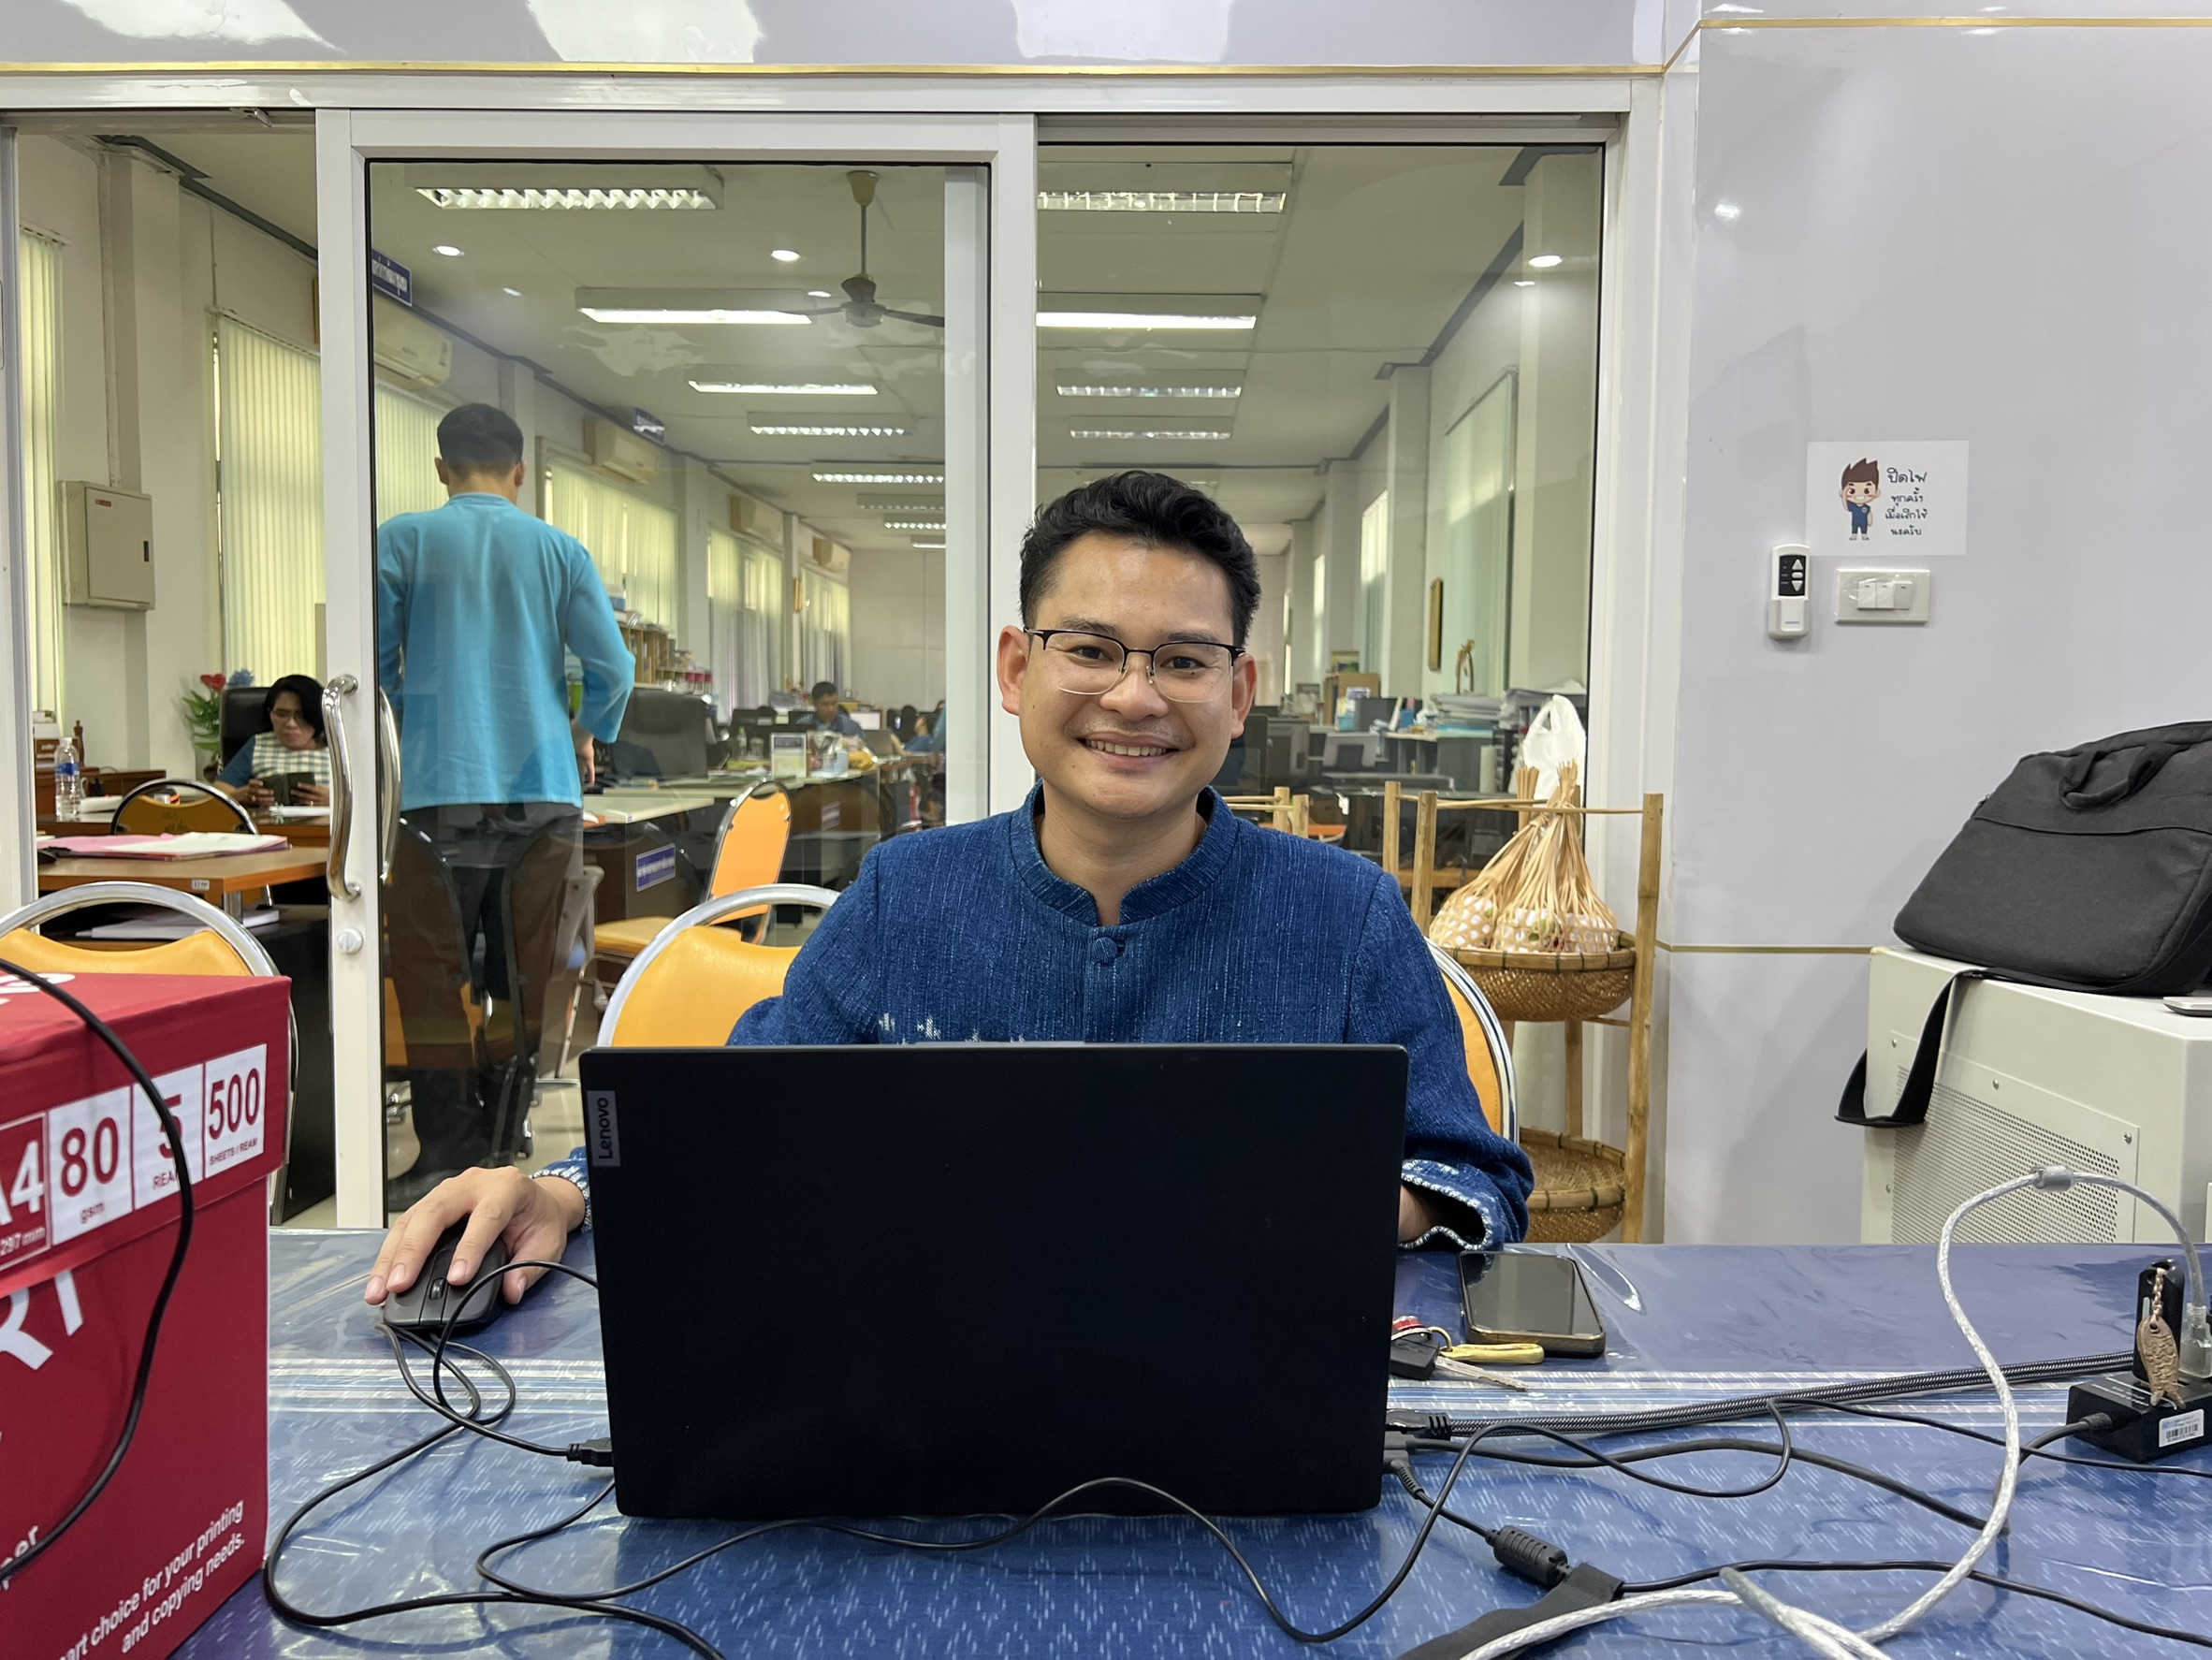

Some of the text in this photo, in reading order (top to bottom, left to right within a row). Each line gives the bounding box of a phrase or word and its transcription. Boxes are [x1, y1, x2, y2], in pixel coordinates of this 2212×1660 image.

[1886, 467, 1928, 483] ปิดไฟ
[1890, 487, 1924, 506] ทุกครั้ง
[1890, 524, 1922, 535] นะครับ
[209, 1068, 261, 1140] 500
[597, 1097, 614, 1159] Lenovo
[61, 1116, 119, 1198] 80
[209, 1146, 236, 1167] SHEETS
[240, 1137, 258, 1153] REAM
[153, 1171, 179, 1190] REA
[80, 1202, 105, 1224] gsm
[0, 1227, 45, 1256] 297 mm
[91, 1583, 139, 1647] choice
[142, 1570, 163, 1601] for
[163, 1542, 195, 1588] your
[196, 1500, 243, 1559] printing
[121, 1532, 245, 1653] and copying needs.
